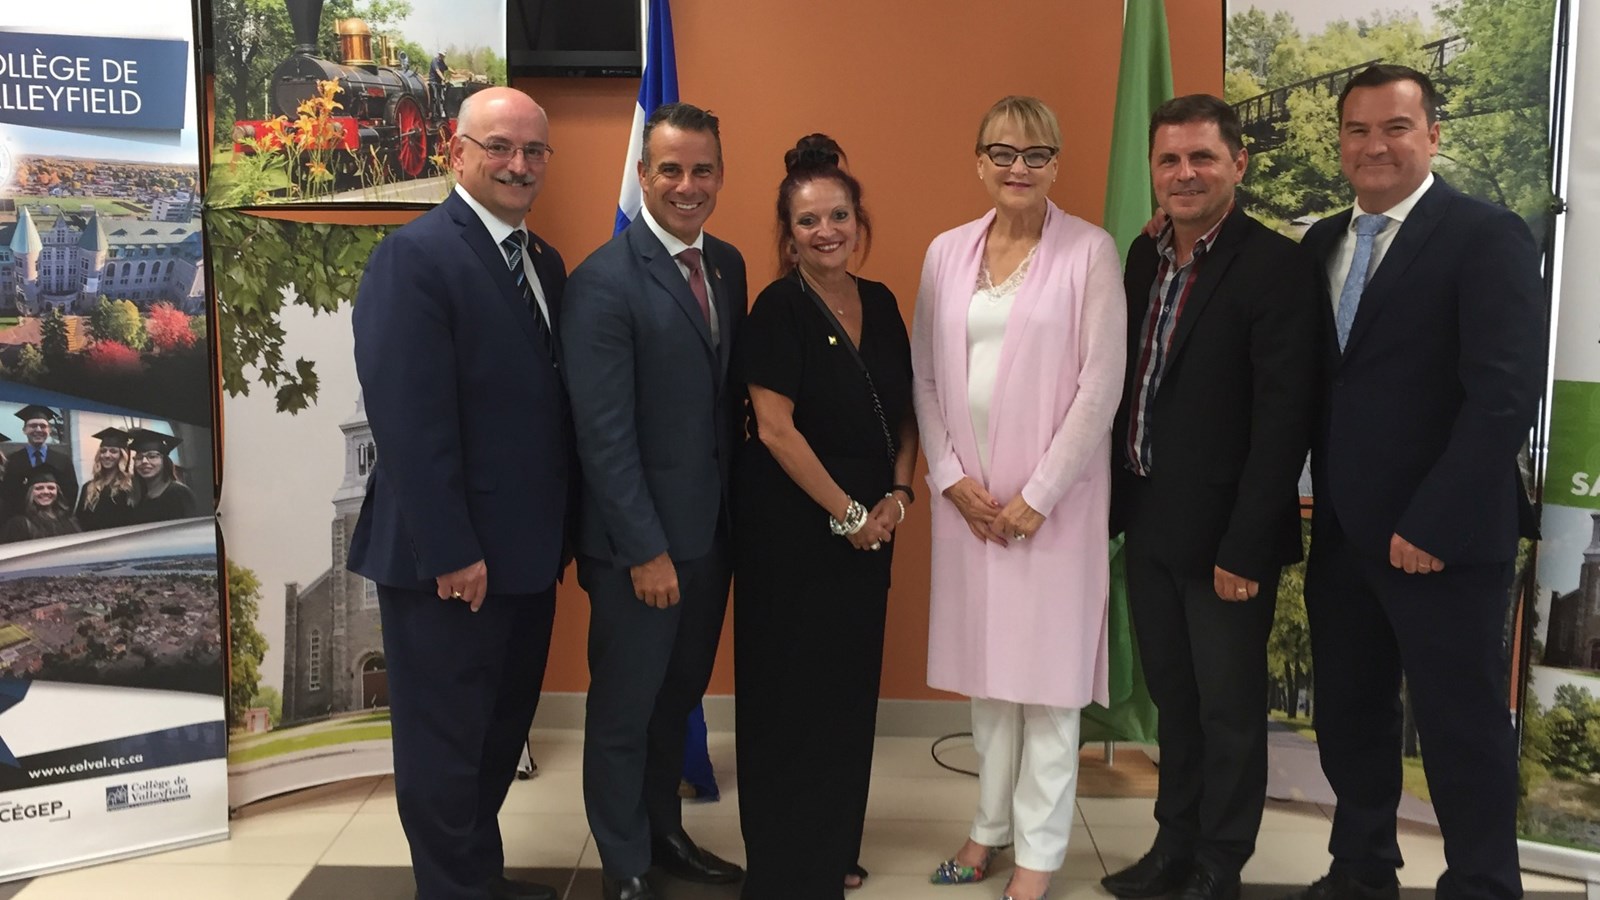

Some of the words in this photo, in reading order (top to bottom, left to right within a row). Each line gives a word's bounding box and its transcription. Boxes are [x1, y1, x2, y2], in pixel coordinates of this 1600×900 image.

[0, 48, 91, 82] LLÈGE
[102, 59, 138, 84] DE
[0, 83, 142, 115] LLEYFIELD
[28, 753, 144, 779] www.colval.qc.ca
[131, 780, 171, 793] Collège
[174, 776, 187, 786] de
[131, 784, 189, 802] Valleyfield
[0, 800, 63, 823] CÉGEP
